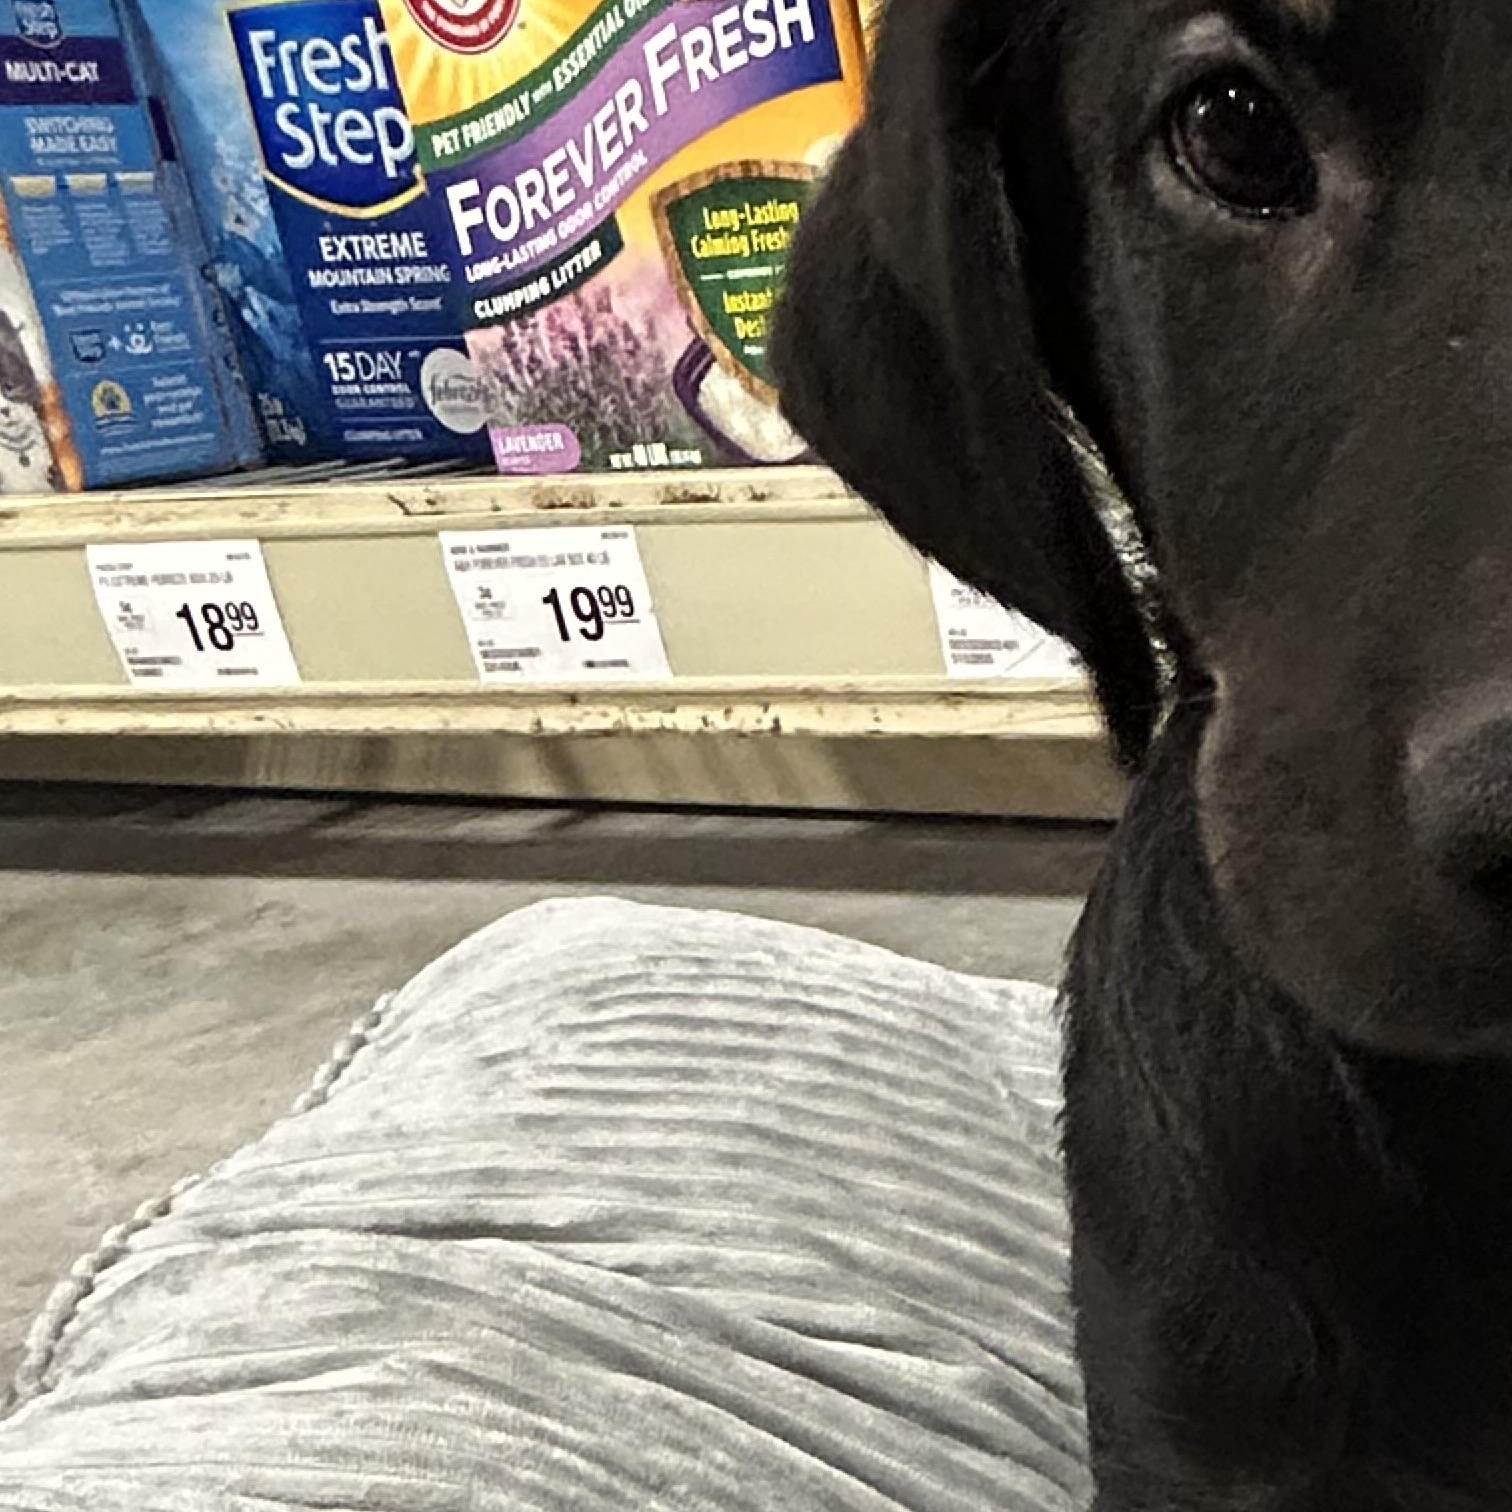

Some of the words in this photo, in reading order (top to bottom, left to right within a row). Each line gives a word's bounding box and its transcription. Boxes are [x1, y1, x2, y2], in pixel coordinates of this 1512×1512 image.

[4, 60, 100, 82] MULTI-CAT
[249, 16, 390, 98] Fresh
[431, 128, 461, 158] PET
[461, 90, 530, 148] FRIENDLY
[552, 4, 625, 92] ESSENTIAL
[275, 102, 414, 178] Step
[446, 78, 649, 256] FOREVER
[643, 0, 815, 116] FRESH
[593, 149, 648, 209] CONTROL
[703, 199, 799, 231] Long-Lasting
[319, 232, 428, 261] EXTREME
[691, 233, 750, 258] Calming
[751, 226, 790, 252] Fresh
[308, 267, 392, 288] MOUNTAIN
[396, 264, 451, 284] SPRING
[474, 277, 550, 319] CLUMPING
[551, 240, 601, 288] LITTER
[500, 432, 564, 454] LAVENDER
